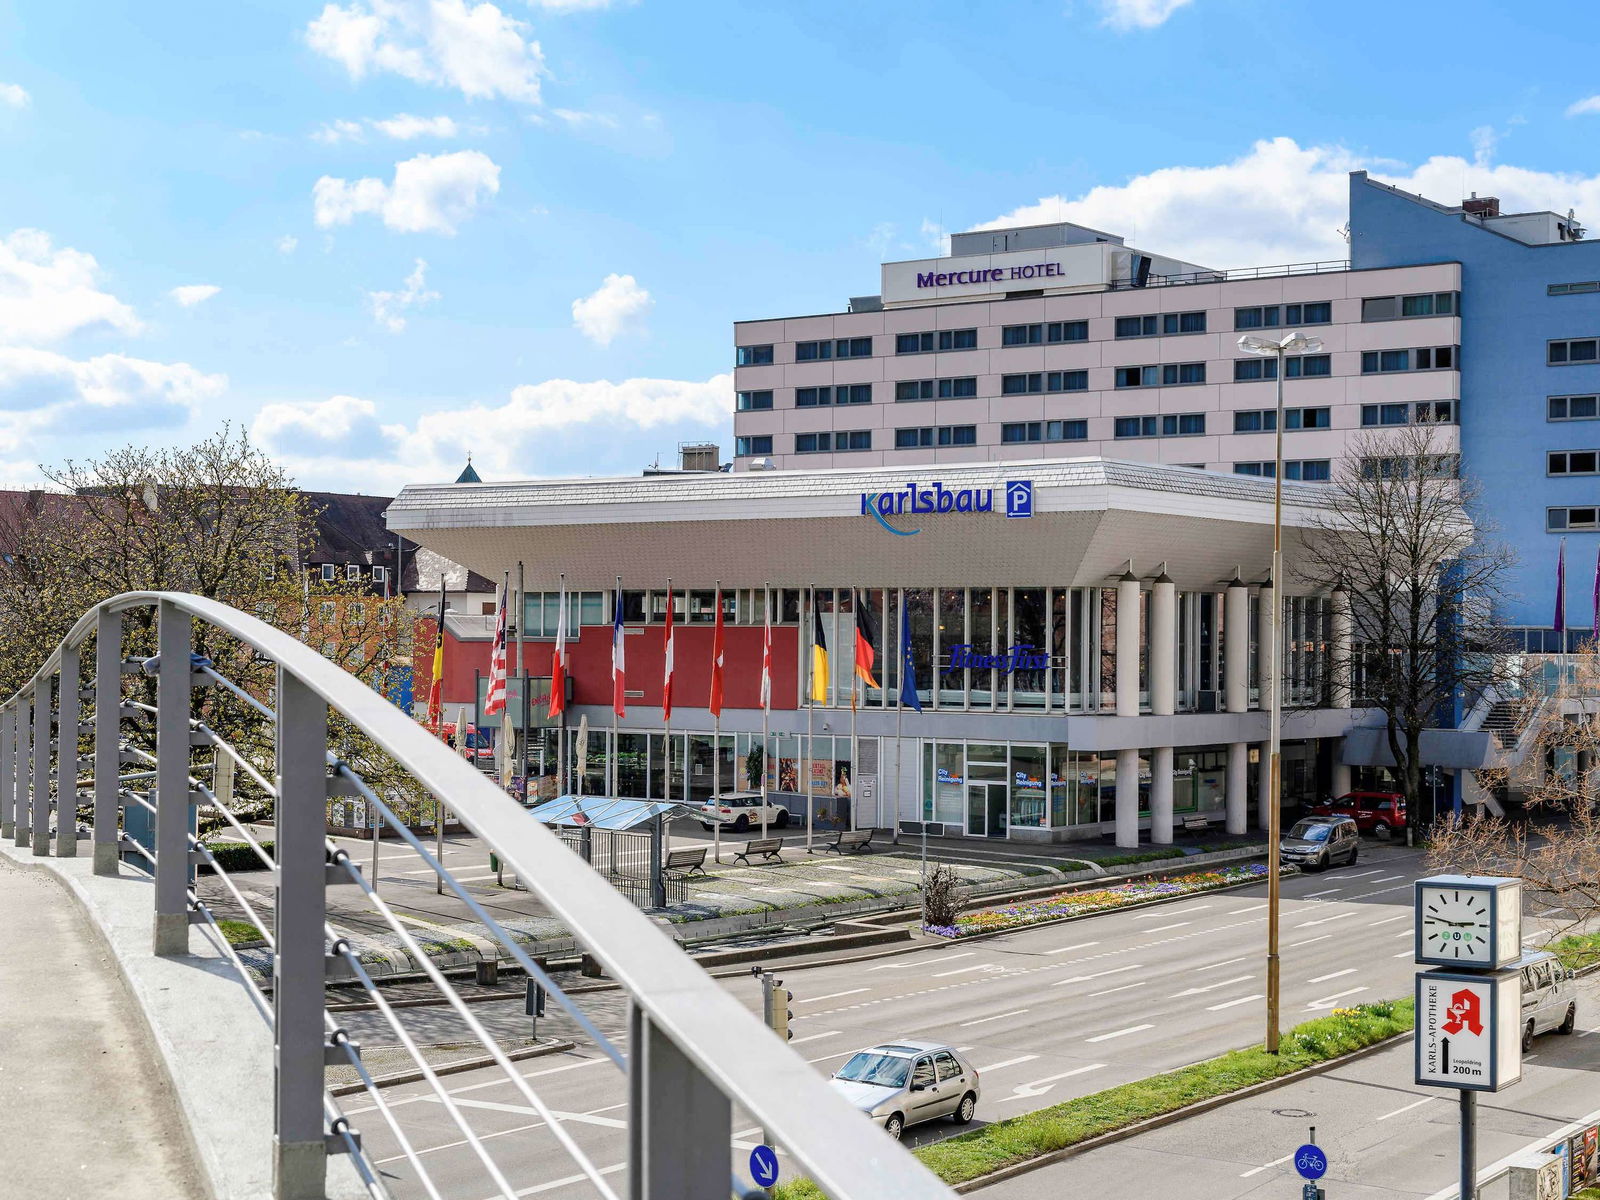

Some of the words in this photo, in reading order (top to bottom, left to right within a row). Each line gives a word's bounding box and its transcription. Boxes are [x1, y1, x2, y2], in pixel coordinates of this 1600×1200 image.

[917, 267, 1003, 288] Mercure
[1010, 262, 1065, 280] HOTEL
[861, 482, 993, 535] Karlsbau
[1001, 644, 1051, 676] First
[1015, 771, 1027, 779] City
[1016, 779, 1042, 787] Reinigung
[1428, 985, 1438, 1074] KARLS-APOTHEKE
[1453, 1066, 1471, 1075] 200
[1472, 1067, 1482, 1076] m
